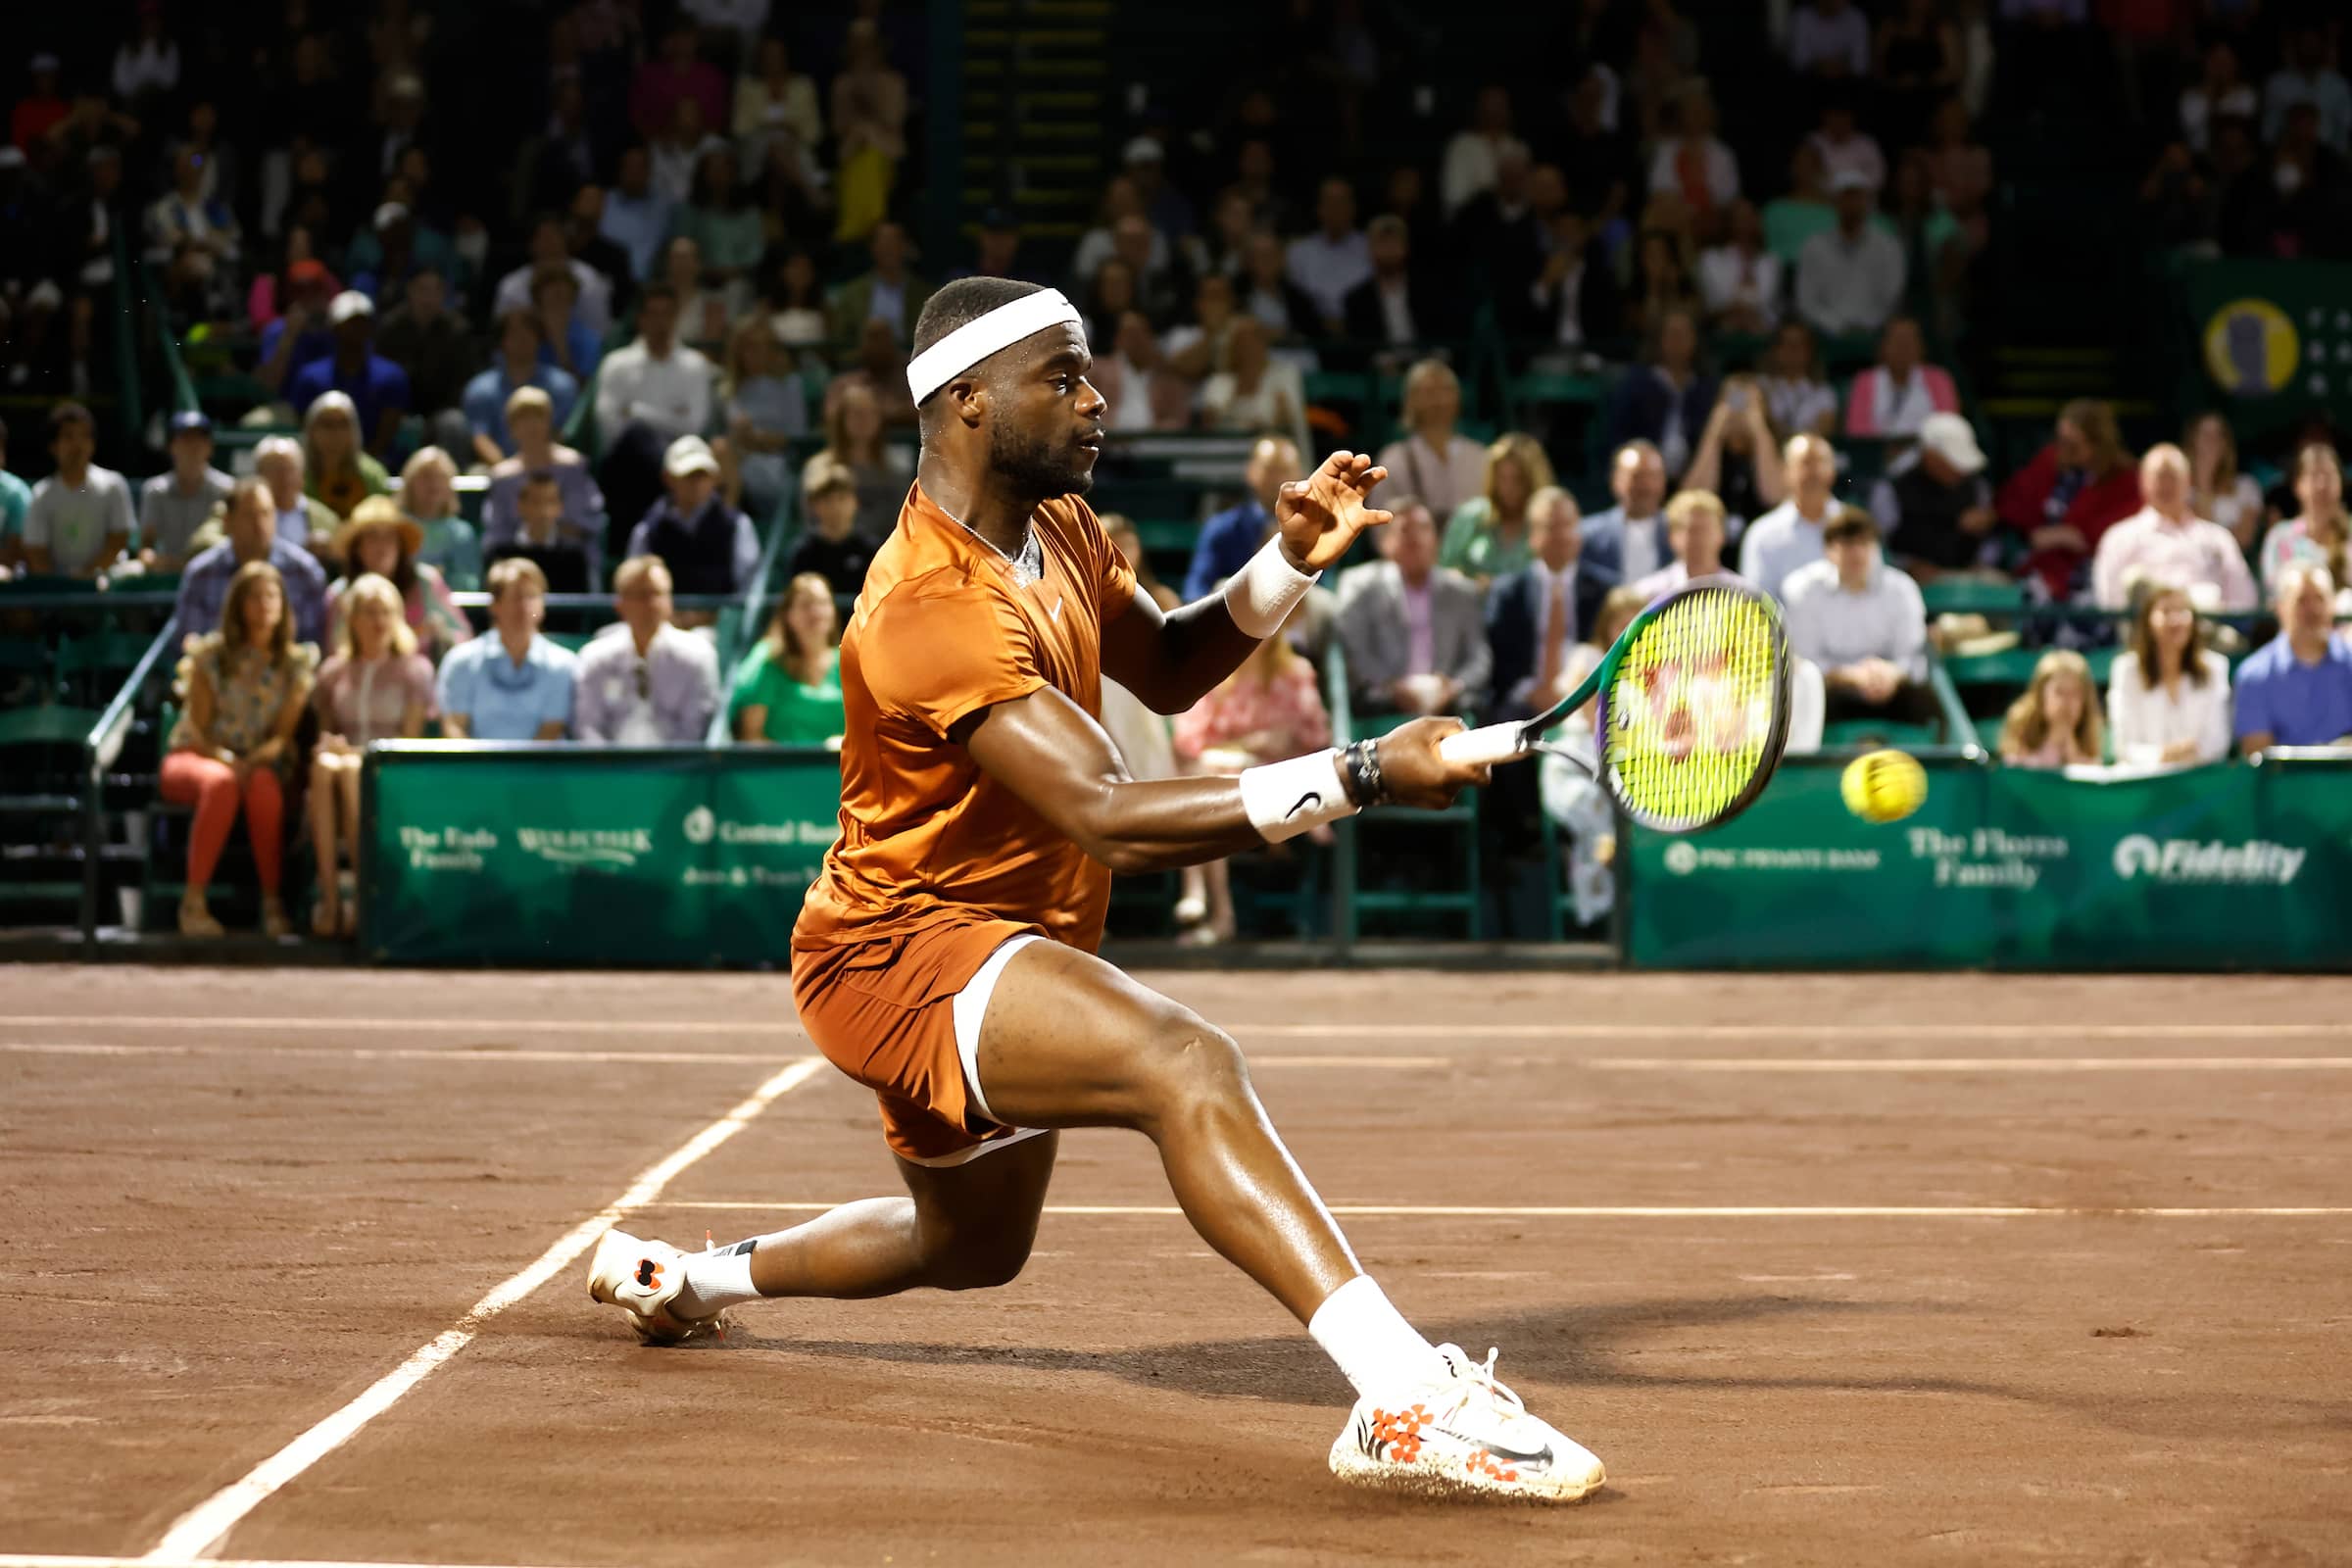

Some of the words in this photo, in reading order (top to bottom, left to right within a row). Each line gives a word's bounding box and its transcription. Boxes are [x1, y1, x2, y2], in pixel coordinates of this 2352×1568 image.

[399, 826, 439, 850] The
[1906, 826, 1967, 858] The
[2161, 839, 2306, 884] Fidelity
